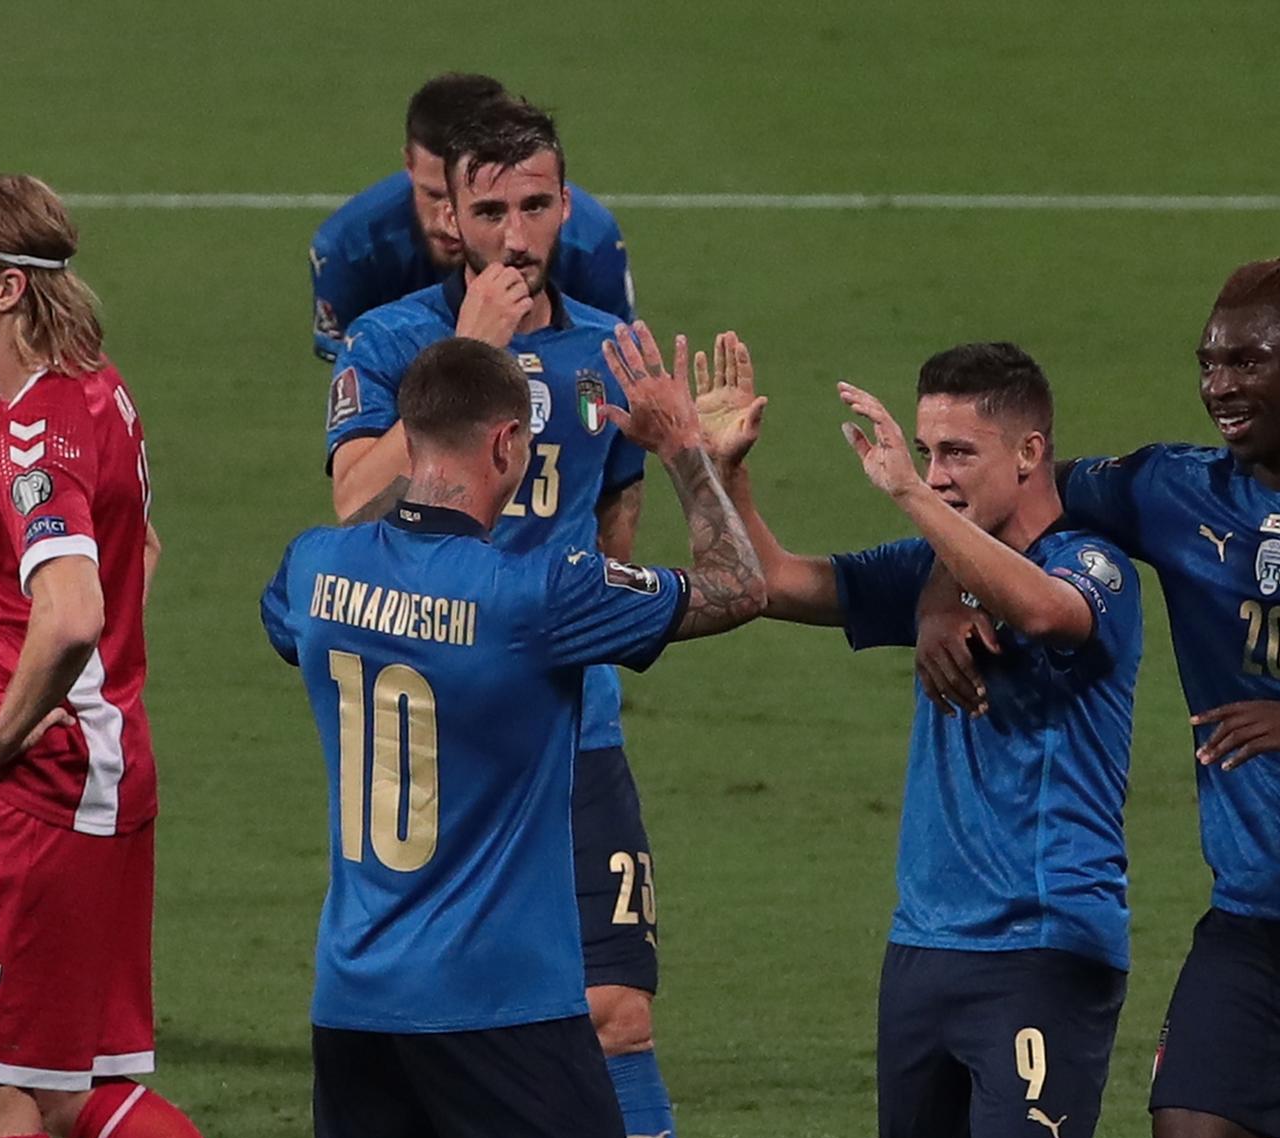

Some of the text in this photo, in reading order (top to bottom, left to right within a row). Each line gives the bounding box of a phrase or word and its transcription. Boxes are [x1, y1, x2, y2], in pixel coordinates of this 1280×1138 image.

[309, 572, 477, 647] BERNARDESCHI
[328, 649, 439, 873] 10
[609, 851, 657, 926] 23
[1015, 1027, 1047, 1101] 9
